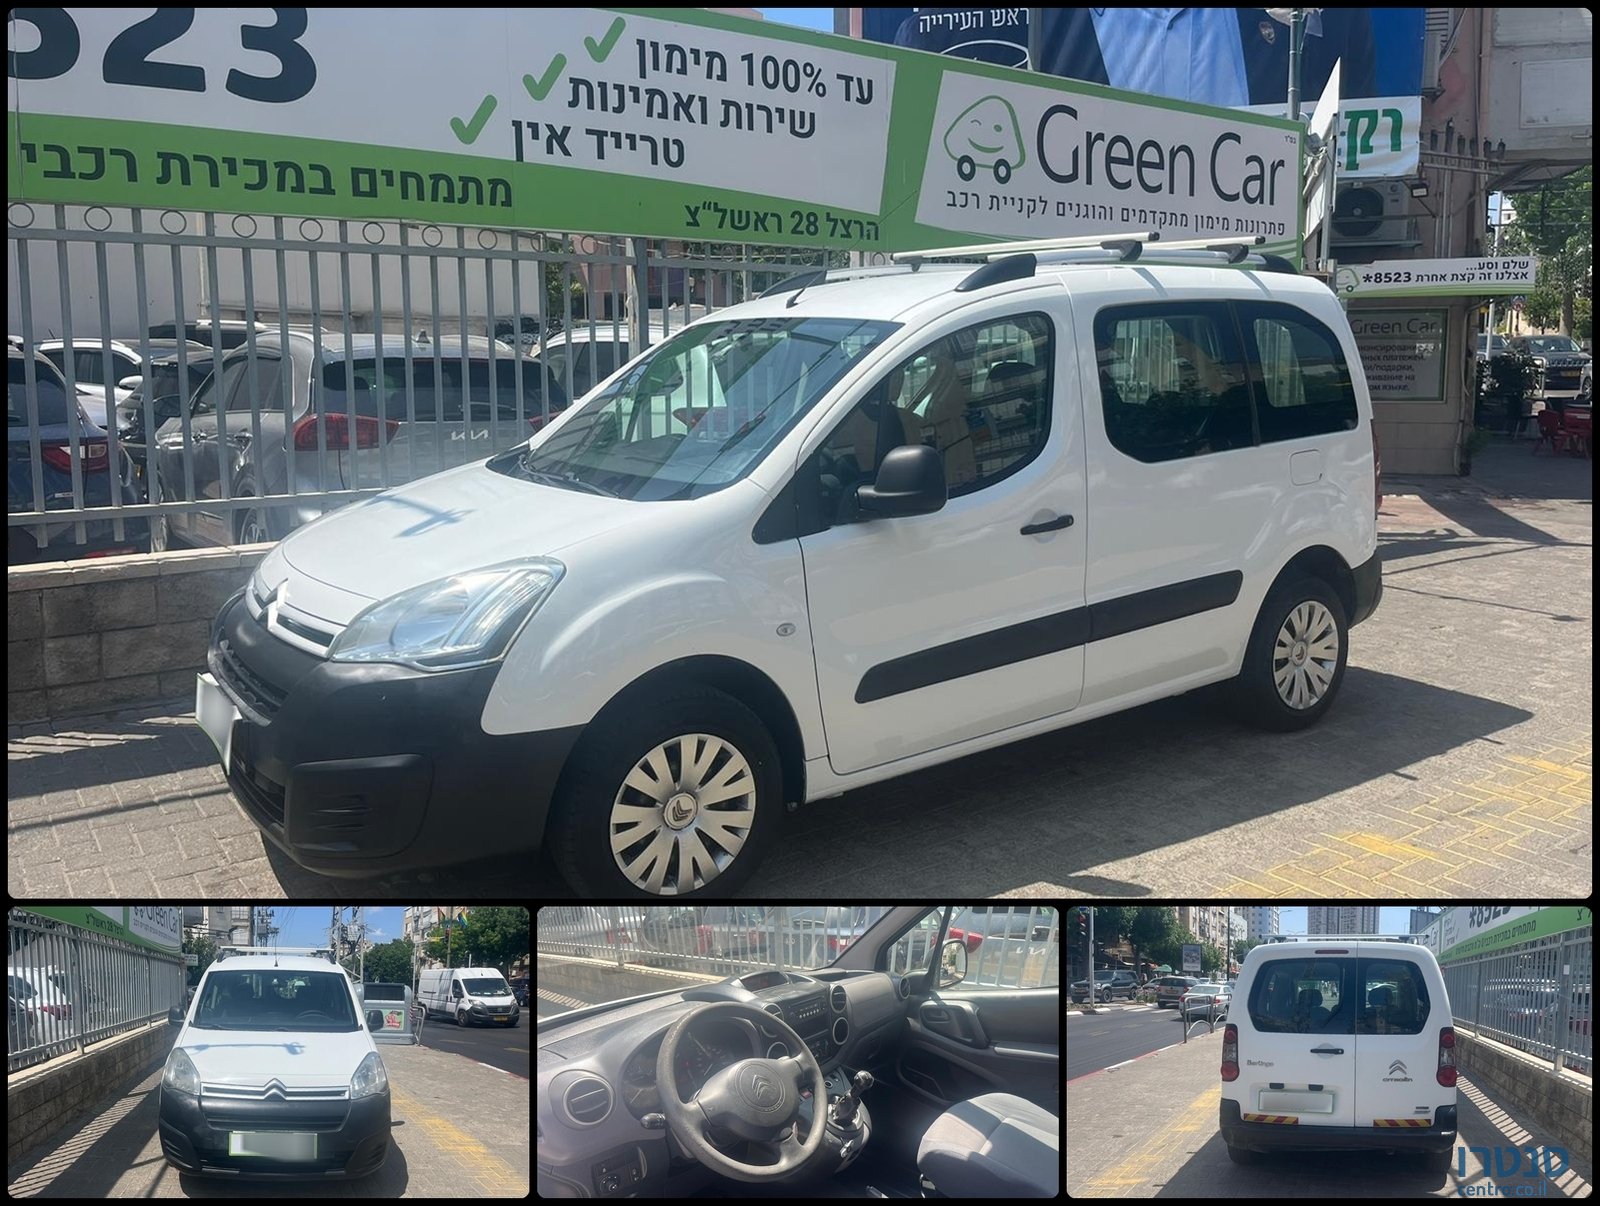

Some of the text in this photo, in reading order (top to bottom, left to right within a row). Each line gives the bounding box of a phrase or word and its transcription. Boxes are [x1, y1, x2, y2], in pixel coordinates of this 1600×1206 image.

[920, 8, 1029, 33] ראש העירייה
[636, 38, 873, 105] עד 100% מימון
[567, 77, 816, 139] שירות ואמינות
[512, 120, 685, 168] טרייד אין
[1037, 104, 1195, 197] Green
[1210, 132, 1285, 206] Car
[156, 152, 336, 196] במכירת
[351, 167, 512, 207] מתמחים
[790, 210, 819, 236] 28
[826, 212, 879, 241] הרצל
[946, 190, 1285, 236] פתרונות מימון מתקדמים והוגנים לקניית רכב
[1415, 273, 1448, 283] אחרת
[1450, 272, 1475, 283] קצת
[1479, 273, 1492, 281] זה
[1495, 270, 1529, 281] אצלנו
[1502, 259, 1529, 270] שלם
[1350, 318, 1437, 334] Green Car
